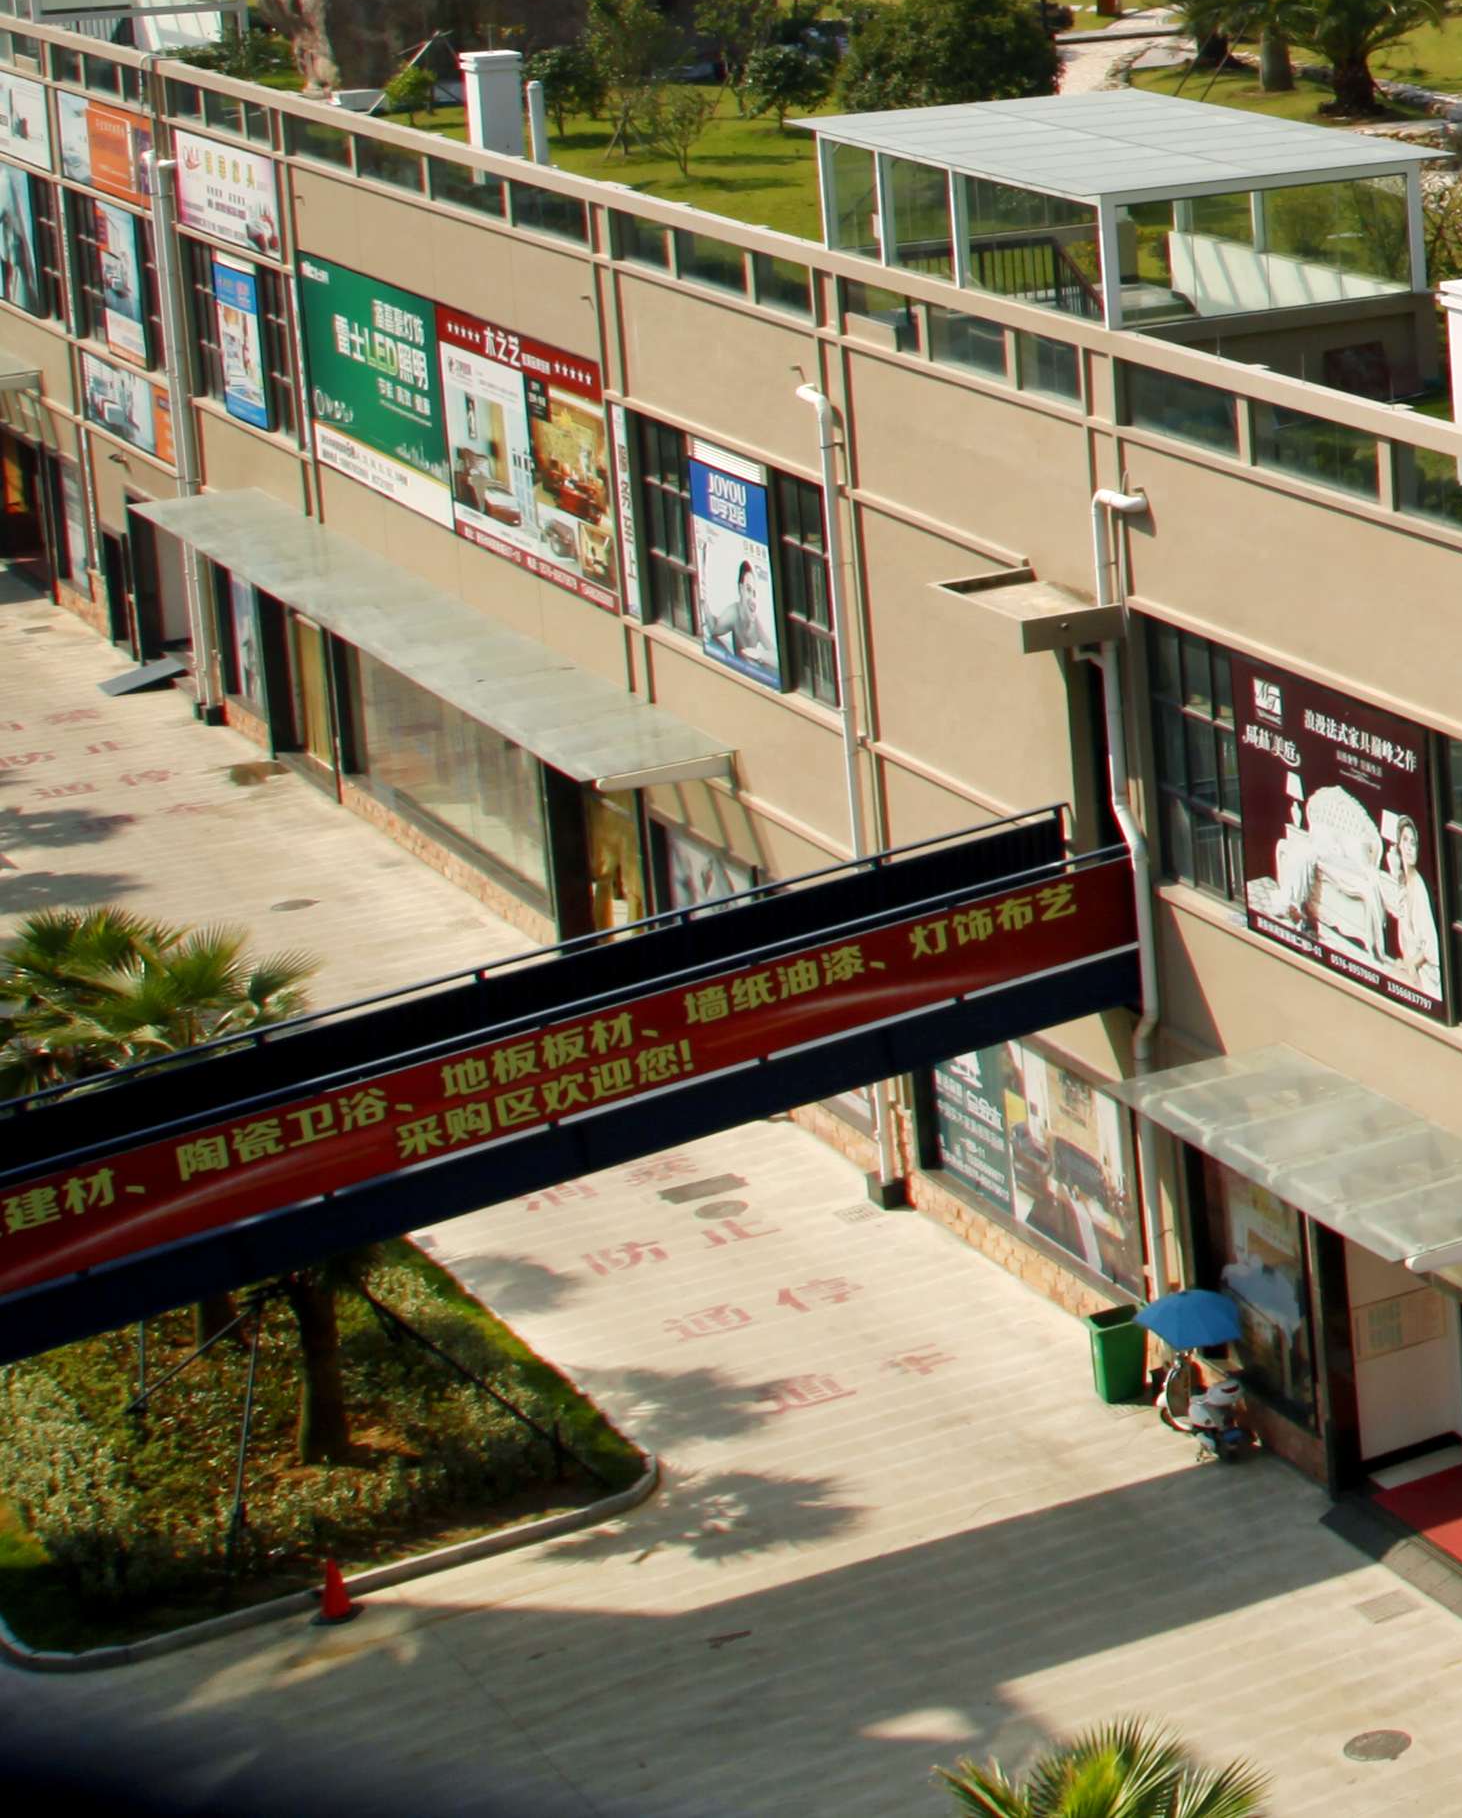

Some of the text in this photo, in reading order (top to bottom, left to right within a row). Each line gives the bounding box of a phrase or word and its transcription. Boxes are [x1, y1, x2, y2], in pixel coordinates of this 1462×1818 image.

[708, 473, 747, 506] JOYOU
[175, 1087, 414, 1181] 陶瓷卫浴、
[440, 1011, 659, 1098] 地板板材、
[682, 944, 887, 1026] 墙纸油漆、
[908, 883, 1077, 960] 灯饰布艺
